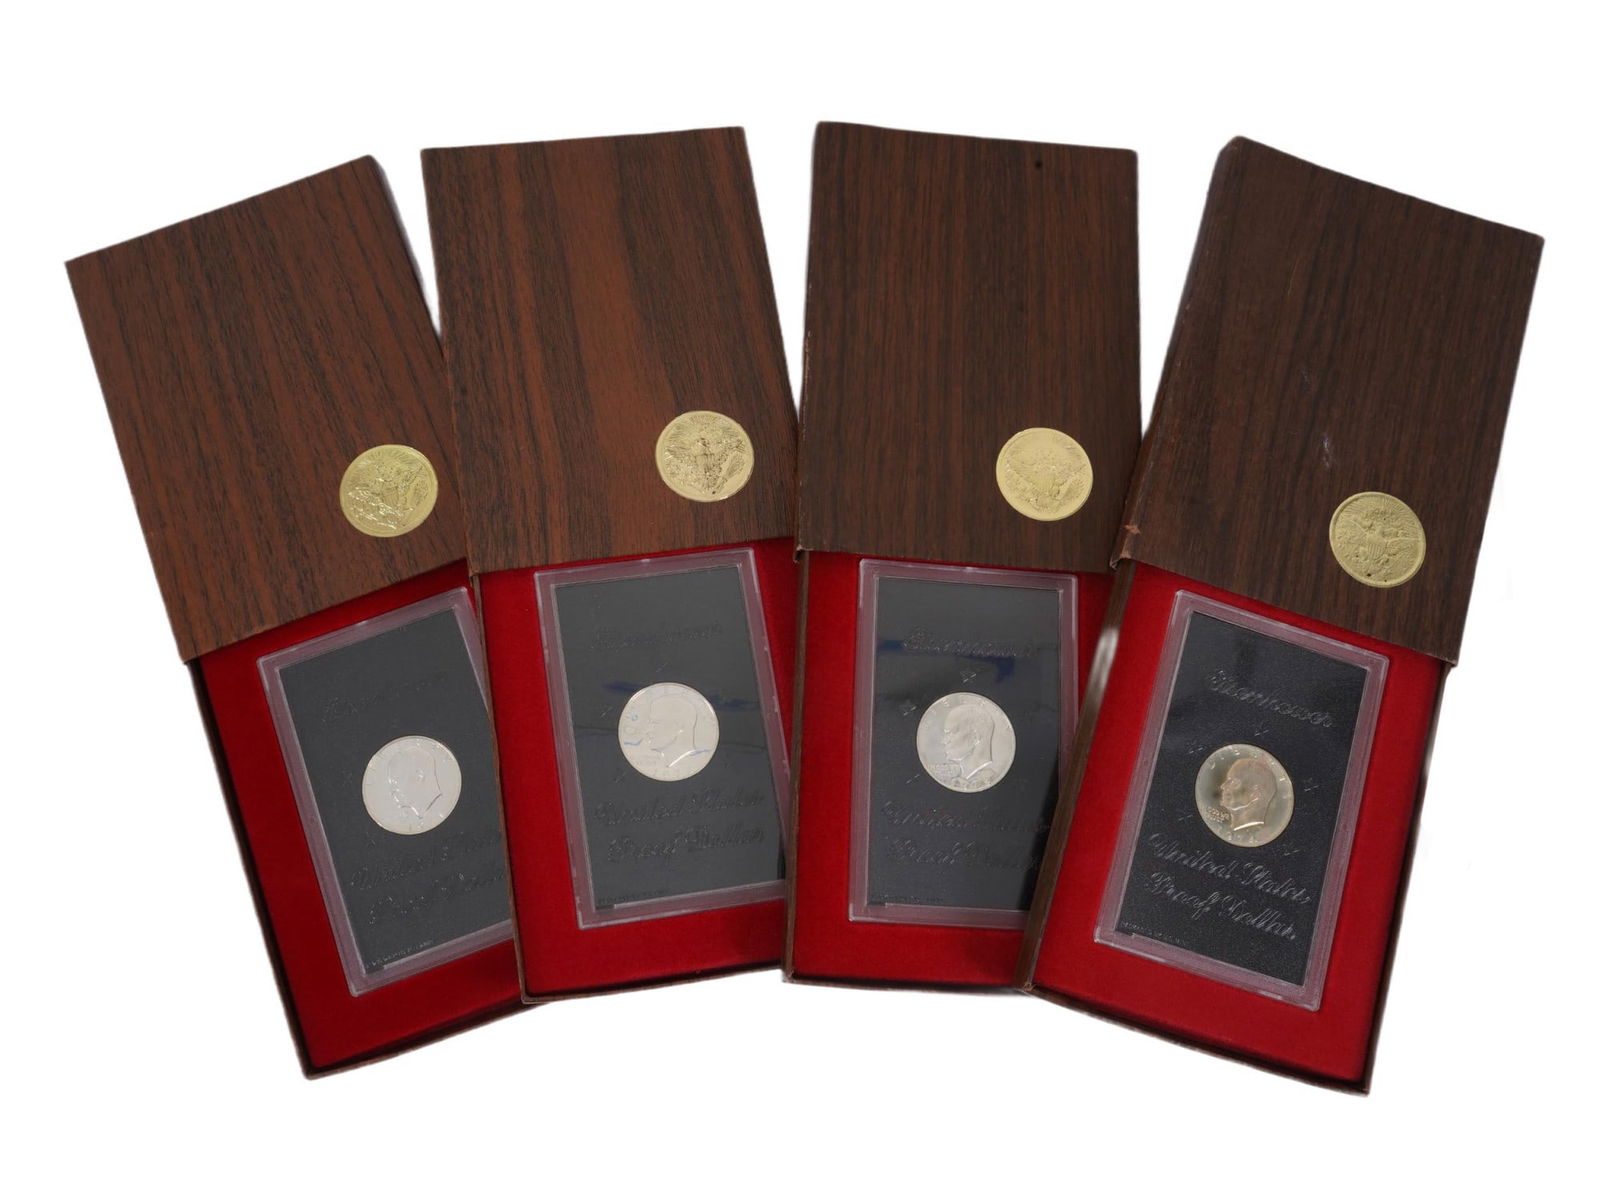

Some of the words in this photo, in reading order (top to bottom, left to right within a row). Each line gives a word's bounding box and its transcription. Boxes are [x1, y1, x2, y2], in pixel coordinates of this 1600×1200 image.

[1150, 832, 1238, 880] United
[1240, 862, 1311, 904] States
[1146, 871, 1222, 921] Proof
[1217, 894, 1297, 941] Dollar
